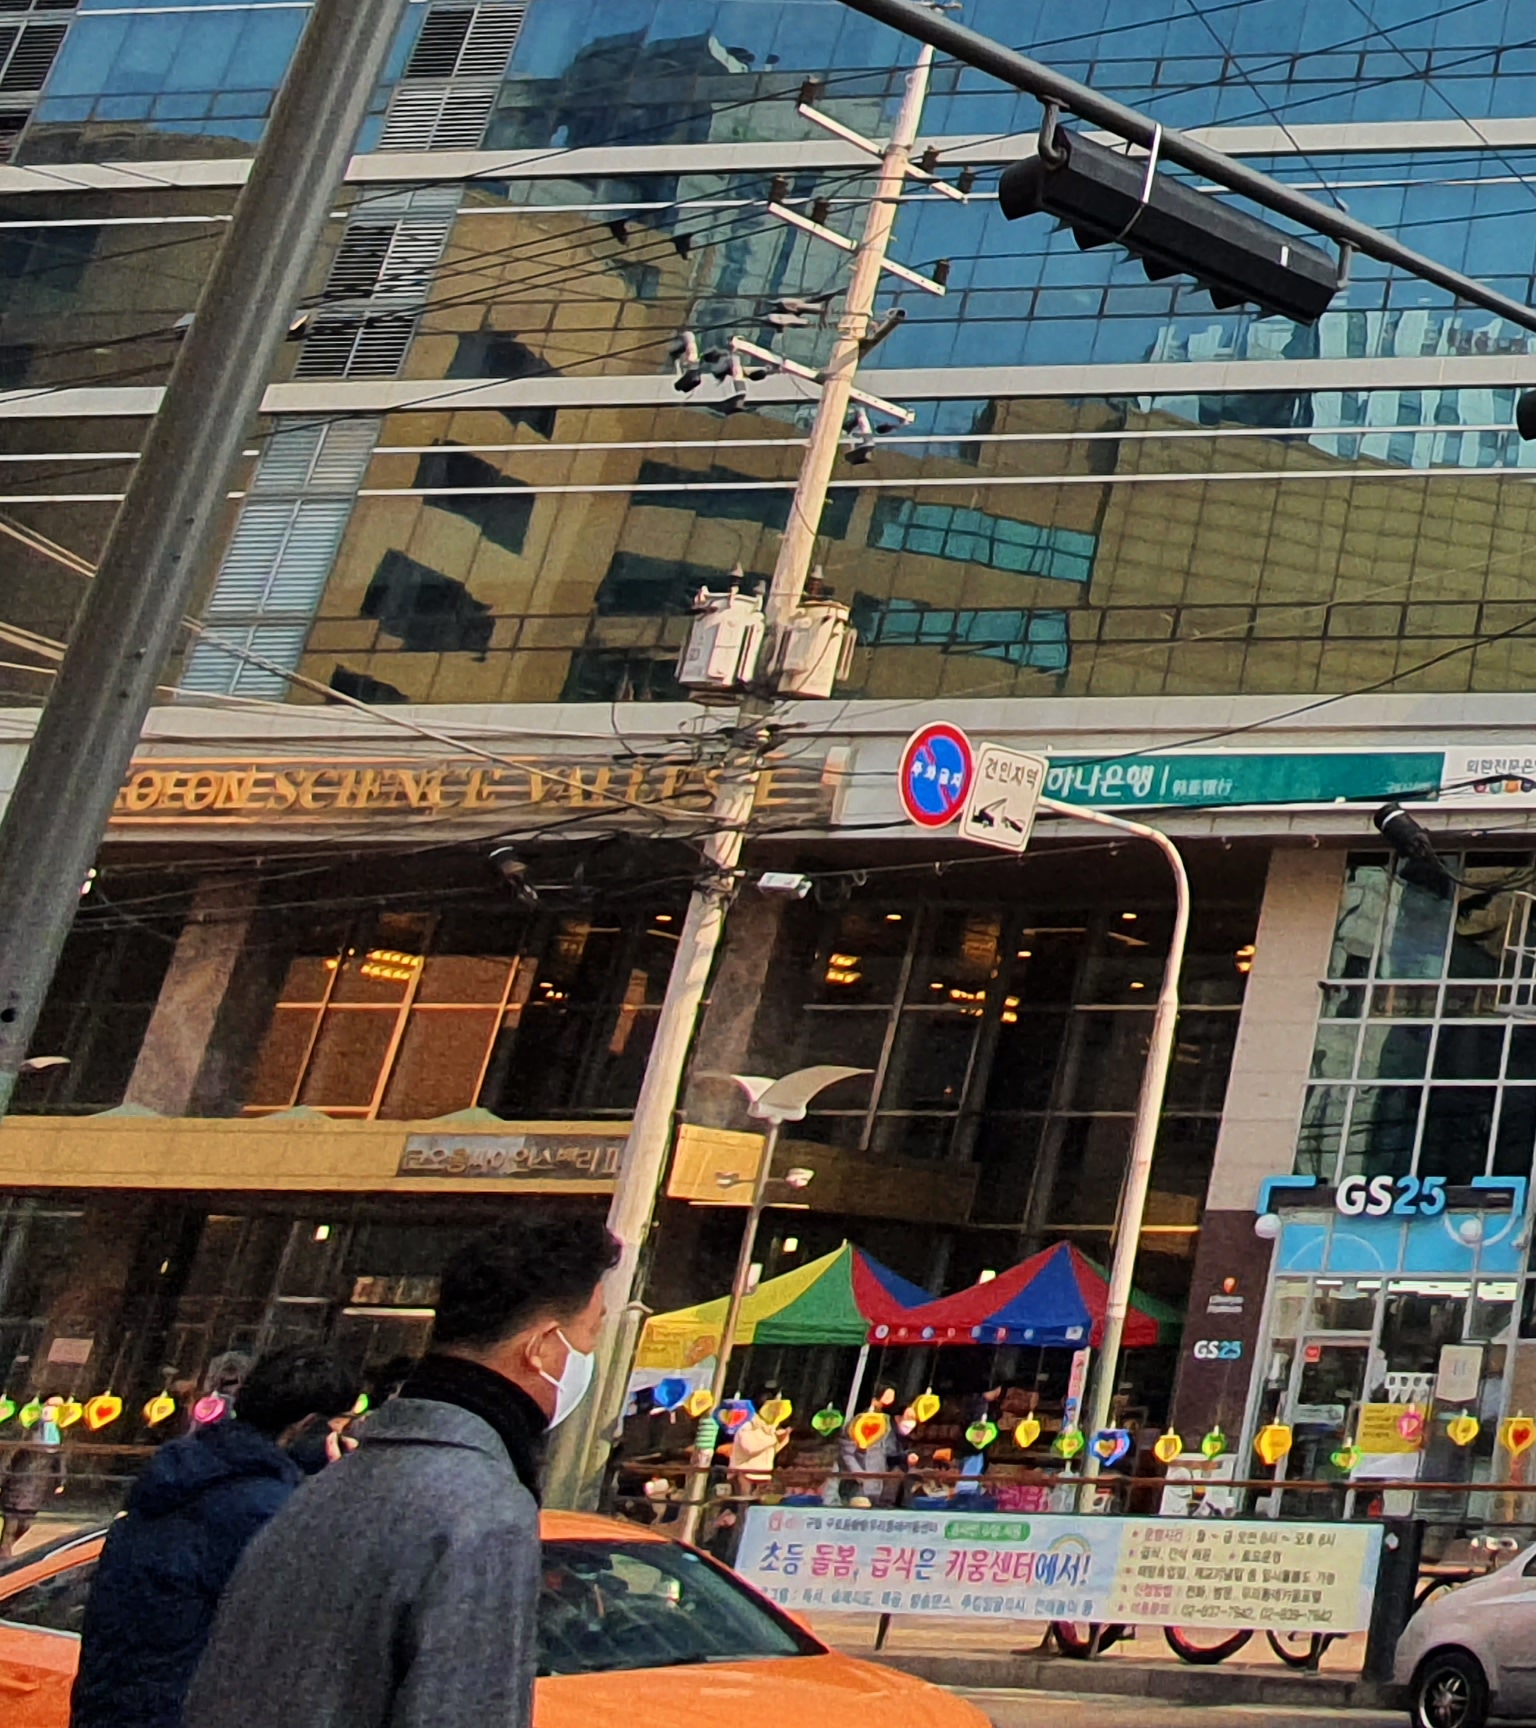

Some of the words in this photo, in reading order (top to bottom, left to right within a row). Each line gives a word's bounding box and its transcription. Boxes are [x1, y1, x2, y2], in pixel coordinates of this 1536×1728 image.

[984, 755, 1040, 792] 견인지역
[1046, 764, 1155, 798] 하나은행
[1334, 1174, 1448, 1217] GS25
[1193, 1339, 1243, 1362] GS25
[758, 1541, 804, 1576] 초등
[810, 1544, 859, 1583] 돌봄,
[871, 1546, 937, 1582] 급식은
[944, 1548, 1092, 1587] 키움센터에서!
